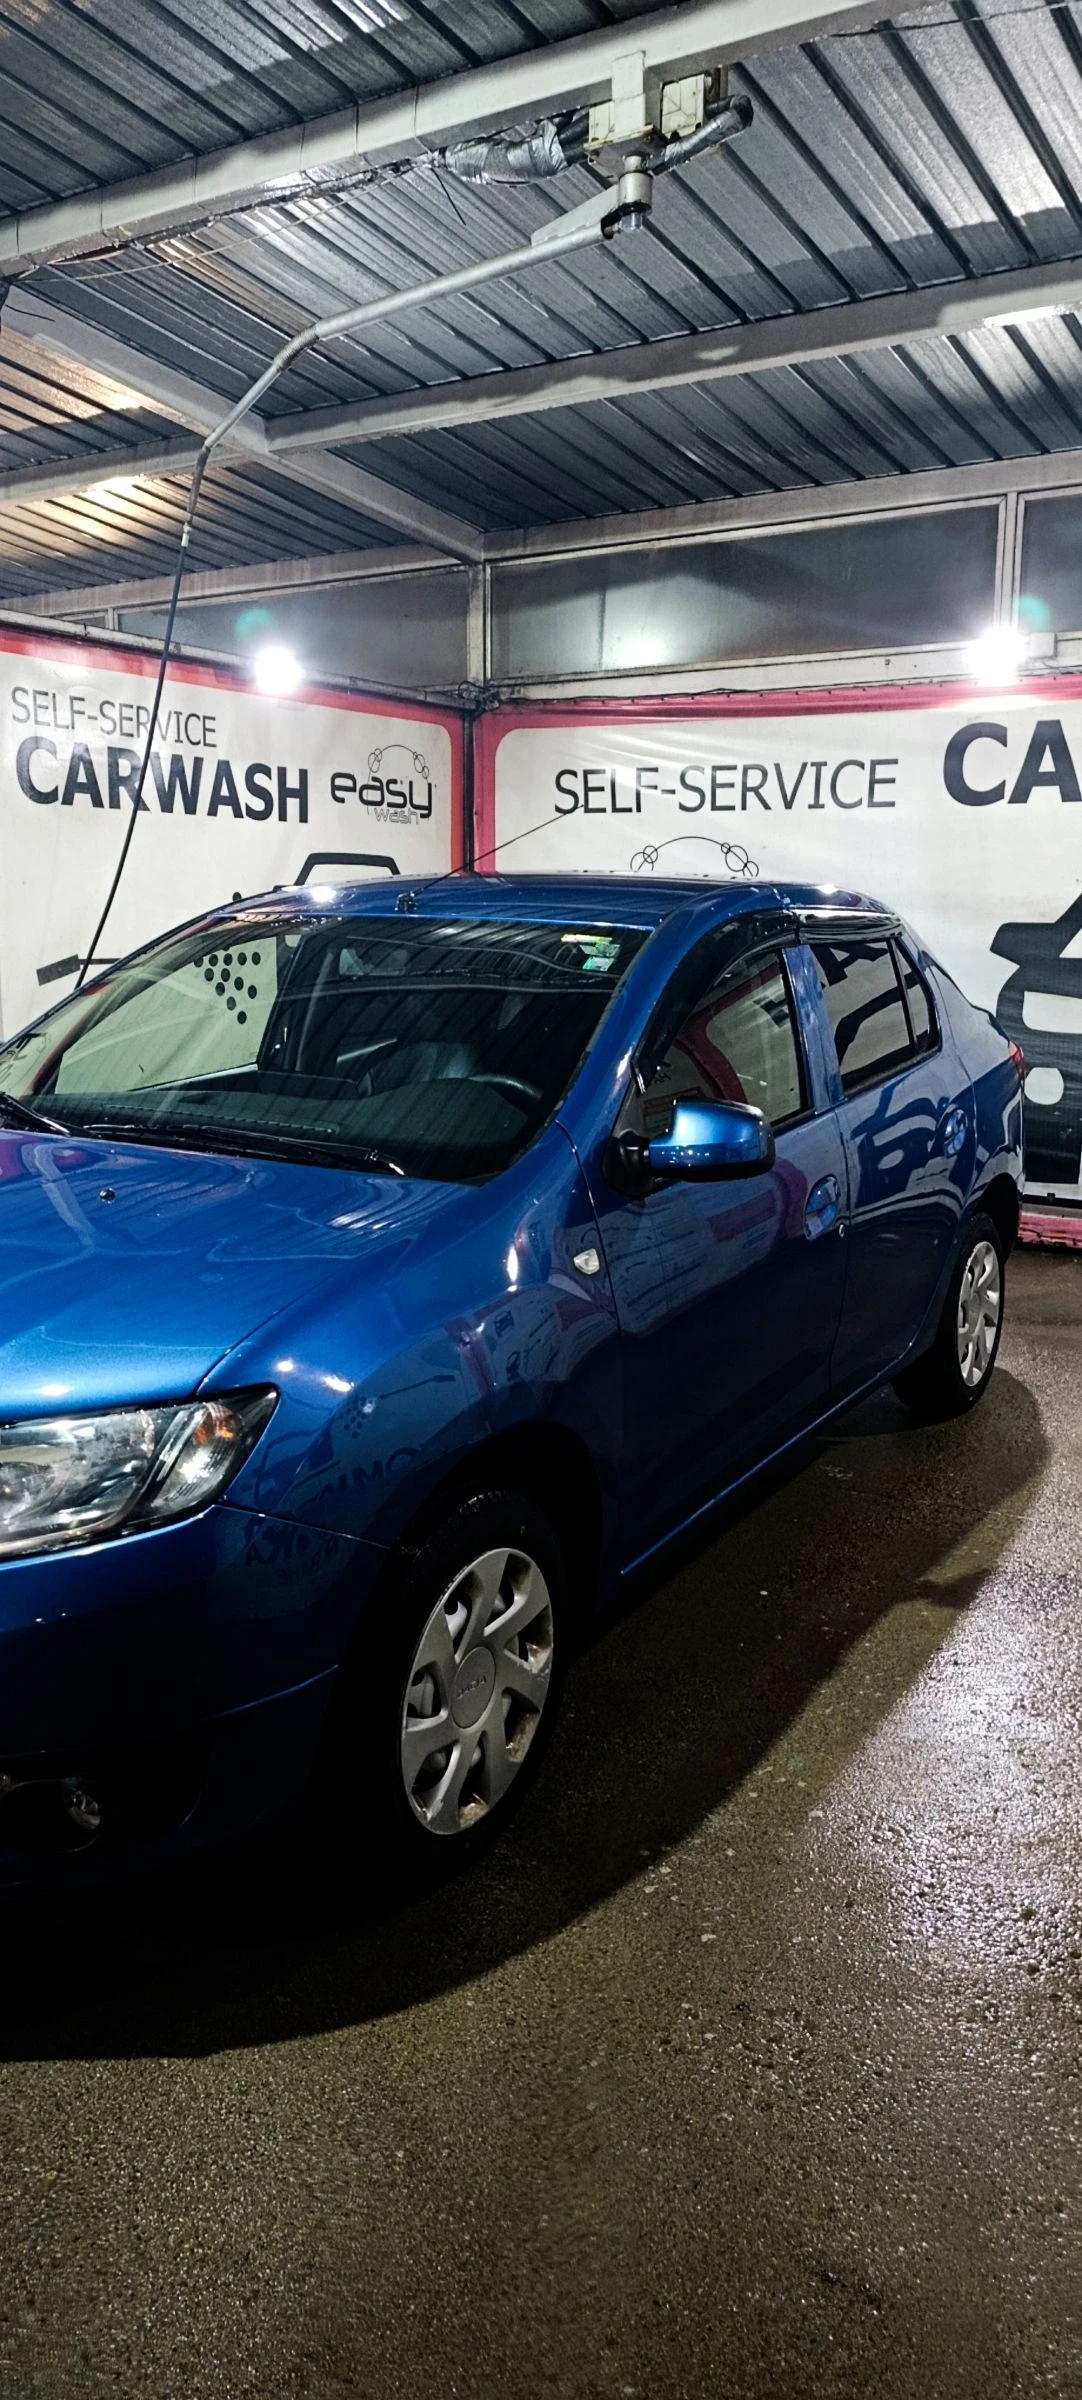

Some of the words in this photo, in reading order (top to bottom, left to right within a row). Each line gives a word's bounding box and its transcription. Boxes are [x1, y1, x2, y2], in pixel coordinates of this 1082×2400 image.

[11, 686, 217, 748] SELF-SERVICE
[15, 736, 309, 823] CARWASH
[330, 772, 433, 818] easy
[554, 758, 899, 814] SELF-SERVICE
[374, 808, 419, 825] wash
